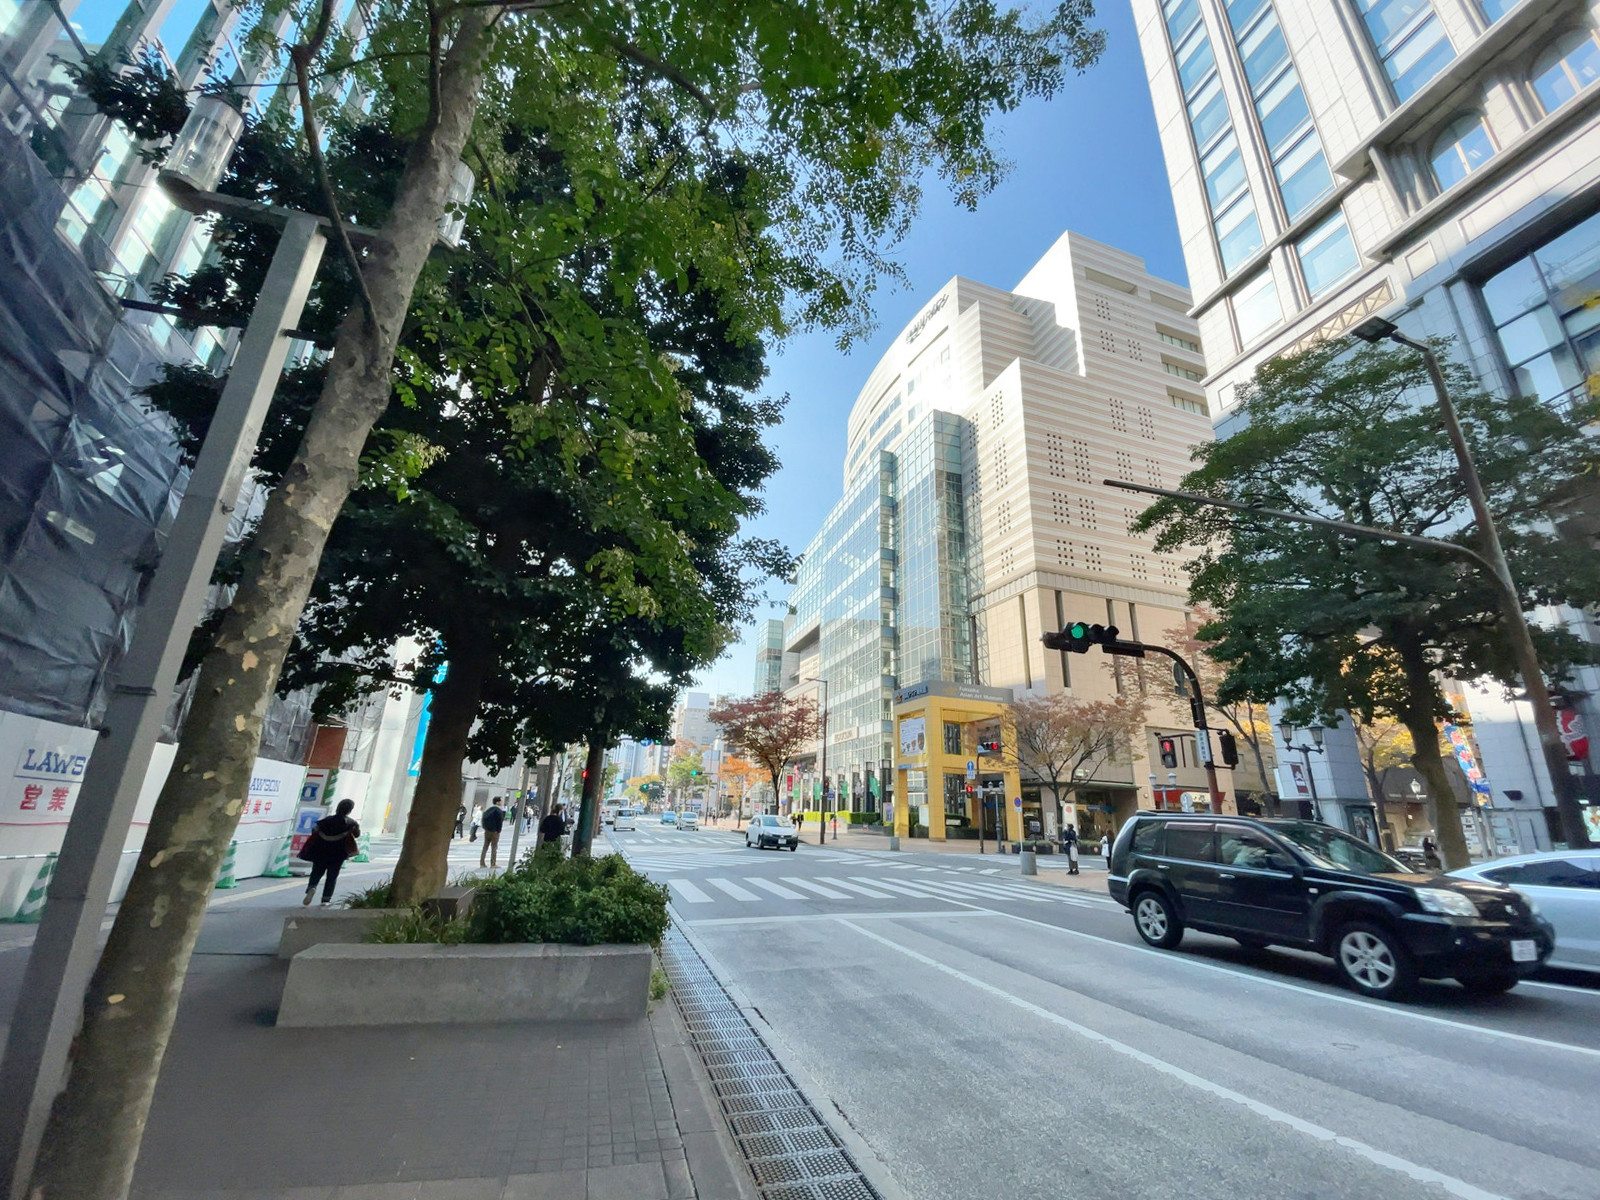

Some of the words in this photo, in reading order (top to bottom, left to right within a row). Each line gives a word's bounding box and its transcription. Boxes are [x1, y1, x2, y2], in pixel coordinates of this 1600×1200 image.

[22, 748, 87, 776] LAWS
[19, 784, 70, 812] 営業
[249, 777, 281, 792] AWSON
